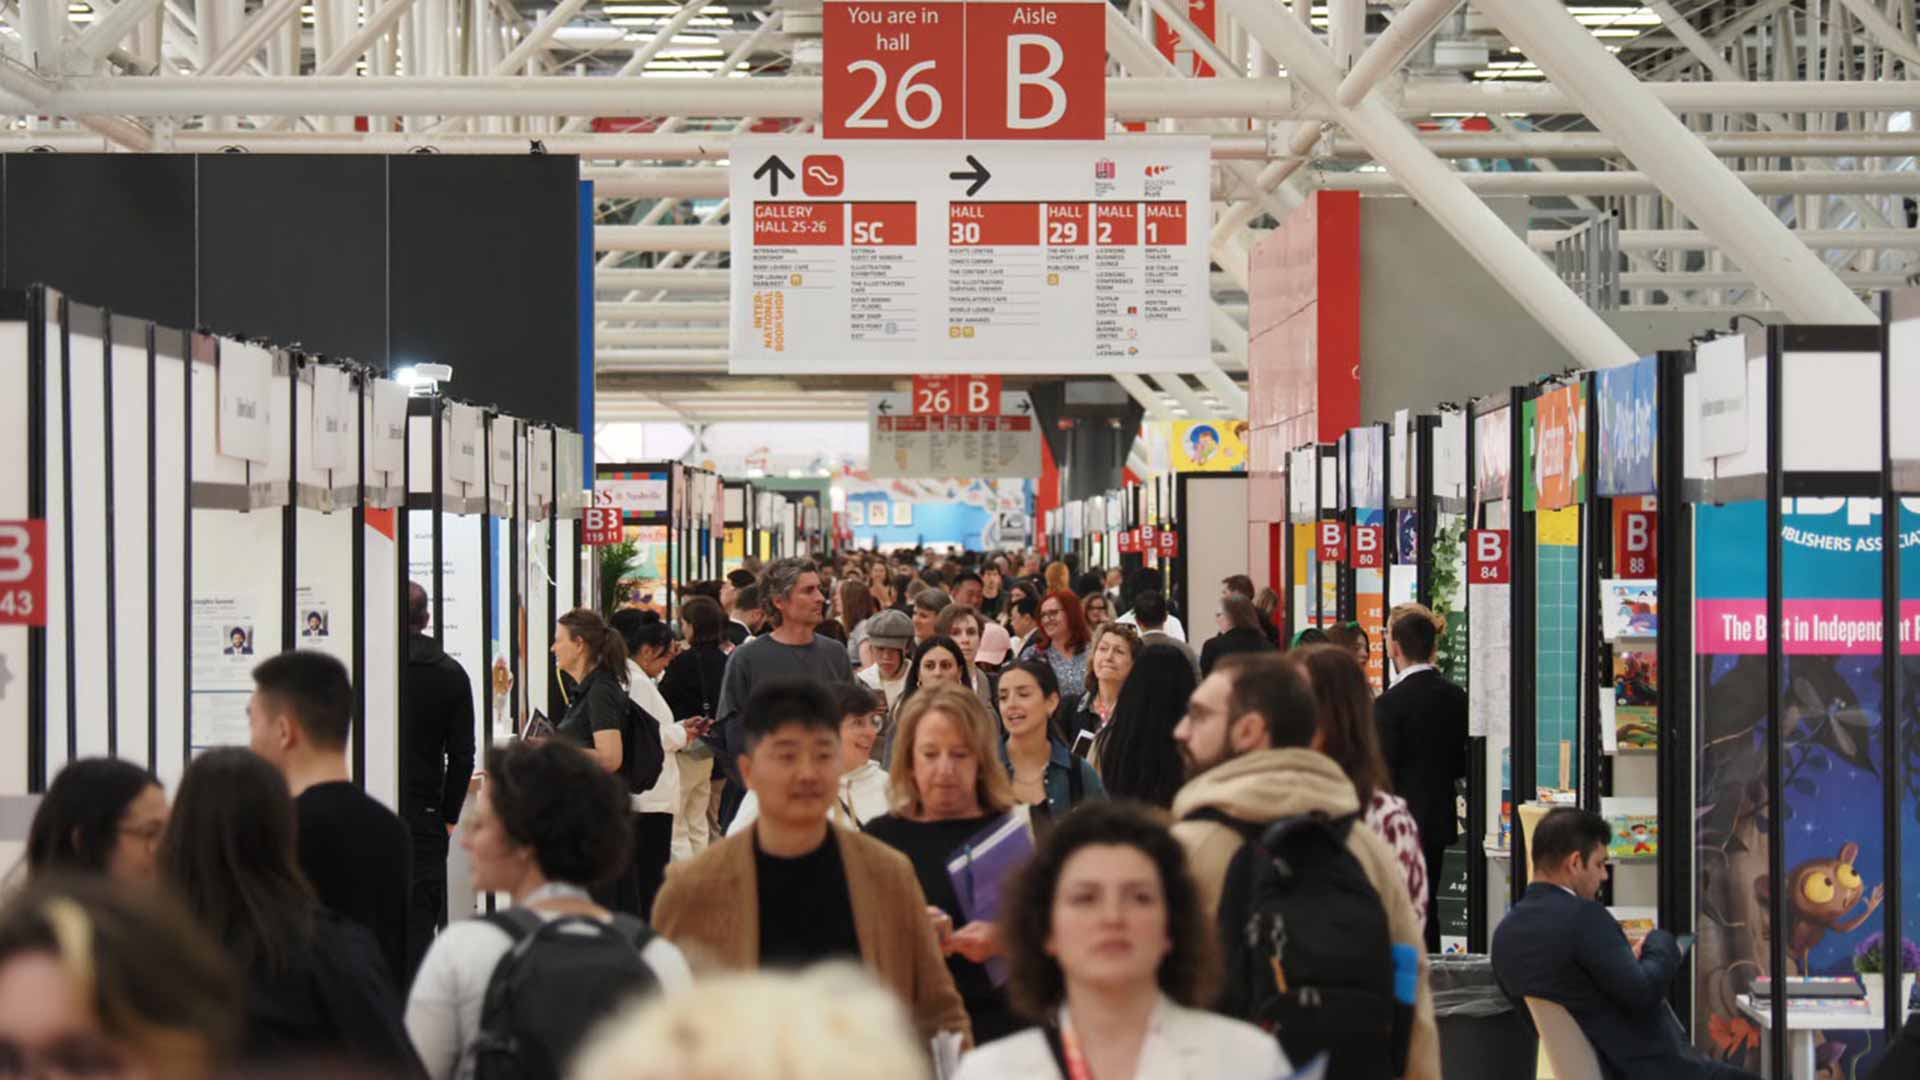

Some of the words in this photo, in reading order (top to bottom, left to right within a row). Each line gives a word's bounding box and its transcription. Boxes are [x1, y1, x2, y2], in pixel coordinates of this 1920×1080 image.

[848, 7, 882, 24] You
[887, 10, 915, 24] are
[921, 7, 938, 24] in
[1013, 7, 1056, 24] Aisle
[876, 33, 910, 50] hall
[1006, 34, 1067, 129] B
[844, 60, 943, 129] 26
[755, 206, 813, 218] GALLERY
[951, 206, 984, 218] HALL
[1049, 206, 1082, 218] HALL
[1098, 206, 1133, 218] MALL
[1147, 206, 1182, 218] MALL
[756, 221, 788, 233] HALL
[791, 221, 827, 233] 25-26
[853, 221, 884, 244] SC
[952, 222, 980, 244] 30
[1049, 222, 1078, 244] 29
[1098, 222, 1112, 244] 2
[1147, 222, 1158, 244] 1
[919, 389, 952, 414] 26
[968, 381, 990, 413] B
[587, 510, 604, 530] B
[1143, 526, 1154, 540] B
[1161, 532, 1174, 548] B
[1323, 524, 1341, 545] B
[1357, 528, 1377, 551] B
[1628, 514, 1648, 552] B
[1781, 525, 1852, 552] BLISHERS
[0, 526, 33, 581] B
[1325, 547, 1339, 558] 76
[1478, 533, 1502, 561] B
[1359, 554, 1373, 565] 80
[1630, 557, 1645, 573] 88
[1480, 566, 1498, 579] 84
[1722, 614, 1753, 642] The
[1755, 614, 1791, 642] Bt
[1794, 615, 1809, 642] in
[1813, 614, 1910, 648] Independt
